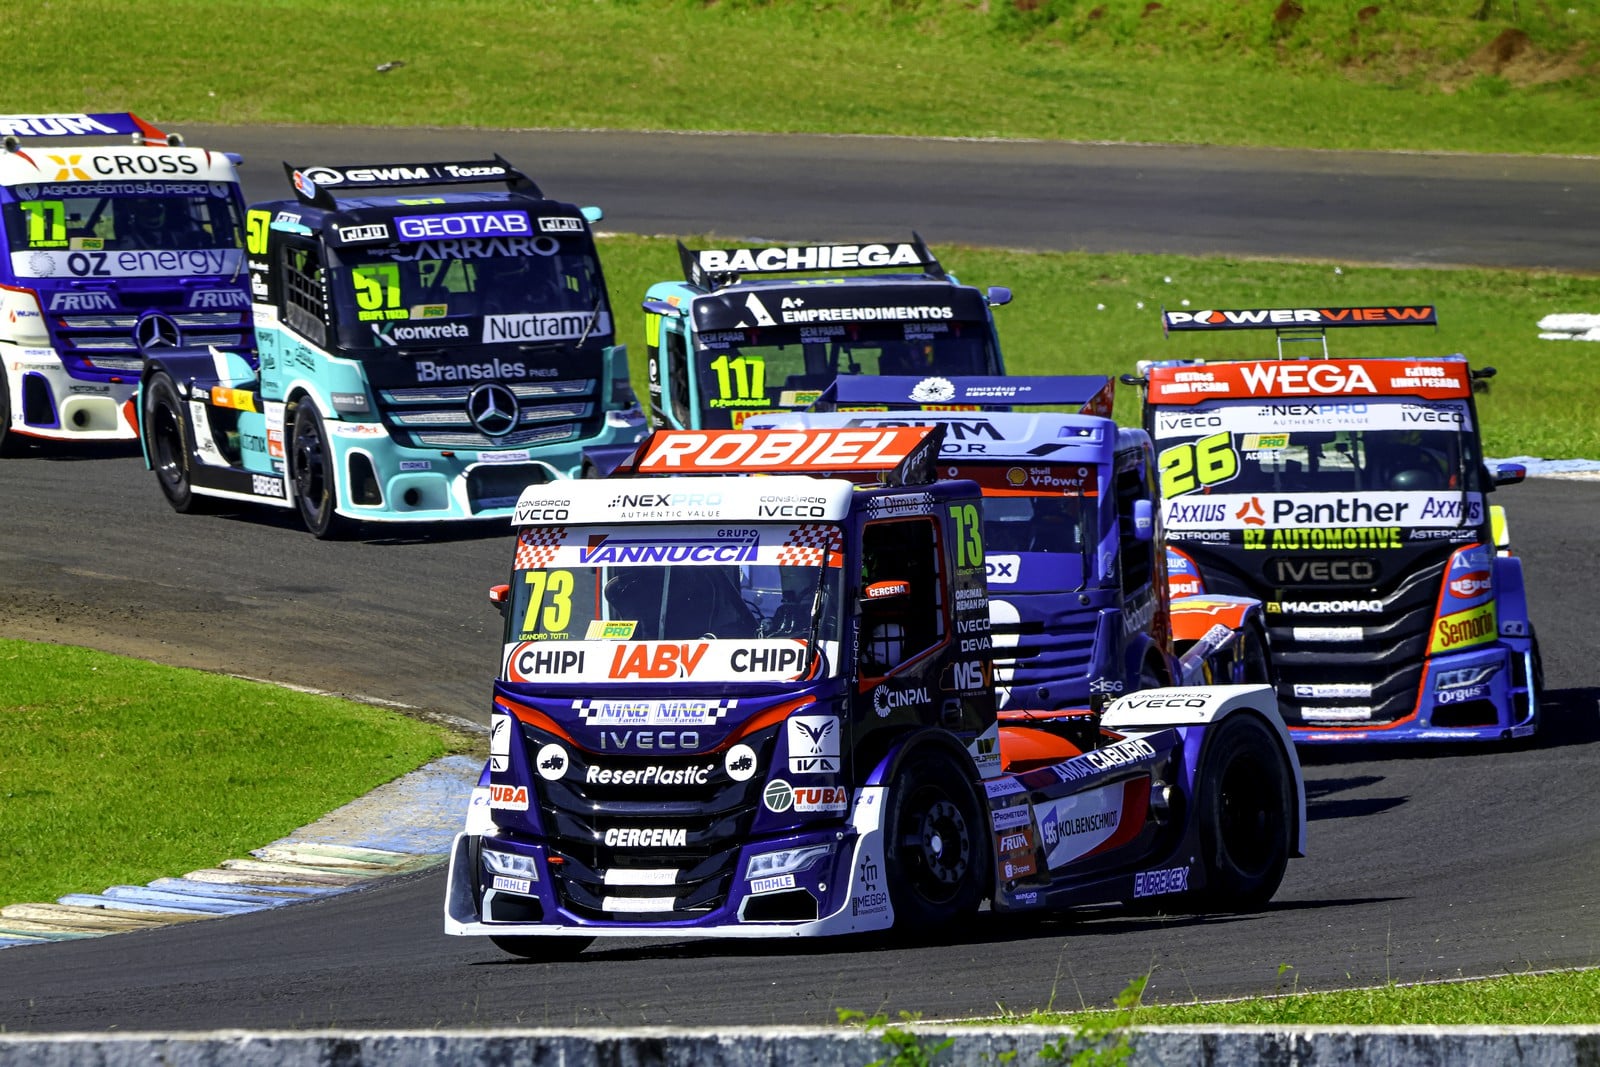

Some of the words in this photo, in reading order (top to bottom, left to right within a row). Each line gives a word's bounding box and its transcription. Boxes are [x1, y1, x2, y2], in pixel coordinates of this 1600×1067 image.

[93, 155, 198, 174] CROSS
[345, 167, 430, 182] GWM
[444, 166, 506, 177] Tozzo
[246, 209, 272, 254] 57
[400, 214, 528, 238] GEOTAB
[390, 235, 560, 261] CARRARO
[67, 253, 111, 276] OZ
[118, 250, 225, 273] energy
[700, 244, 921, 272] BACHIEGA
[352, 262, 400, 310] 57
[49, 292, 117, 310] FRUM
[189, 290, 249, 308] FRUM
[781, 297, 804, 309] A+
[782, 306, 954, 324] EMPREENDIMENTOS
[418, 359, 526, 381] Bransales
[710, 355, 765, 399] 117
[1240, 363, 1377, 395] WEGA
[1160, 417, 1222, 430] IVECO
[1402, 412, 1465, 423] IVECO
[640, 433, 906, 467] ROBIEL
[1259, 439, 1285, 448] PRO
[911, 444, 929, 471] FPT
[1158, 431, 1236, 499] 26
[1030, 467, 1051, 475] Shell
[1031, 475, 1085, 486] V-Power
[514, 509, 569, 521] IVECO
[688, 510, 721, 518] VALUE
[758, 505, 825, 517] IVECO
[1166, 502, 1226, 524] AXXIUS
[1273, 498, 1408, 524] Panther
[717, 529, 758, 537] GRUPO
[950, 504, 983, 567] 73
[1164, 531, 1230, 541] ASTEROIDE
[1243, 529, 1265, 550] BZ
[1272, 528, 1402, 549] AUTOMOTIVE
[1410, 529, 1477, 539] ASTEROIDE
[579, 535, 759, 563] VANNUCCI
[1277, 560, 1373, 581] IVECO
[869, 586, 906, 597] CERCENA
[955, 588, 982, 600] ORIGINAL
[522, 571, 574, 632] 73
[956, 601, 978, 611] REMAN
[1282, 600, 1383, 613] MACROMAQ
[603, 627, 631, 637] PRO
[957, 618, 991, 634] IVECO
[961, 637, 991, 652] DEVA
[519, 651, 584, 674] CHIPI
[730, 649, 805, 672] CHIPI
[953, 660, 993, 690] MSV
[887, 687, 931, 707] CINPAL
[1438, 686, 1481, 703] Orgus
[1117, 699, 1206, 710] IVECO
[600, 731, 699, 749] IVECO
[586, 765, 709, 784] ReserPlastic
[794, 788, 847, 804] TUBA
[993, 808, 1028, 822] PROMETEON
[1059, 810, 1118, 837] KOLBENSCHMIDT
[604, 828, 687, 847] CERCENA
[1001, 833, 1029, 852] FRUM
[1013, 863, 1030, 874] Shopee
[495, 879, 528, 891] MAHLE
[753, 878, 792, 891] MAHLE
[857, 893, 887, 908] MEGGA
